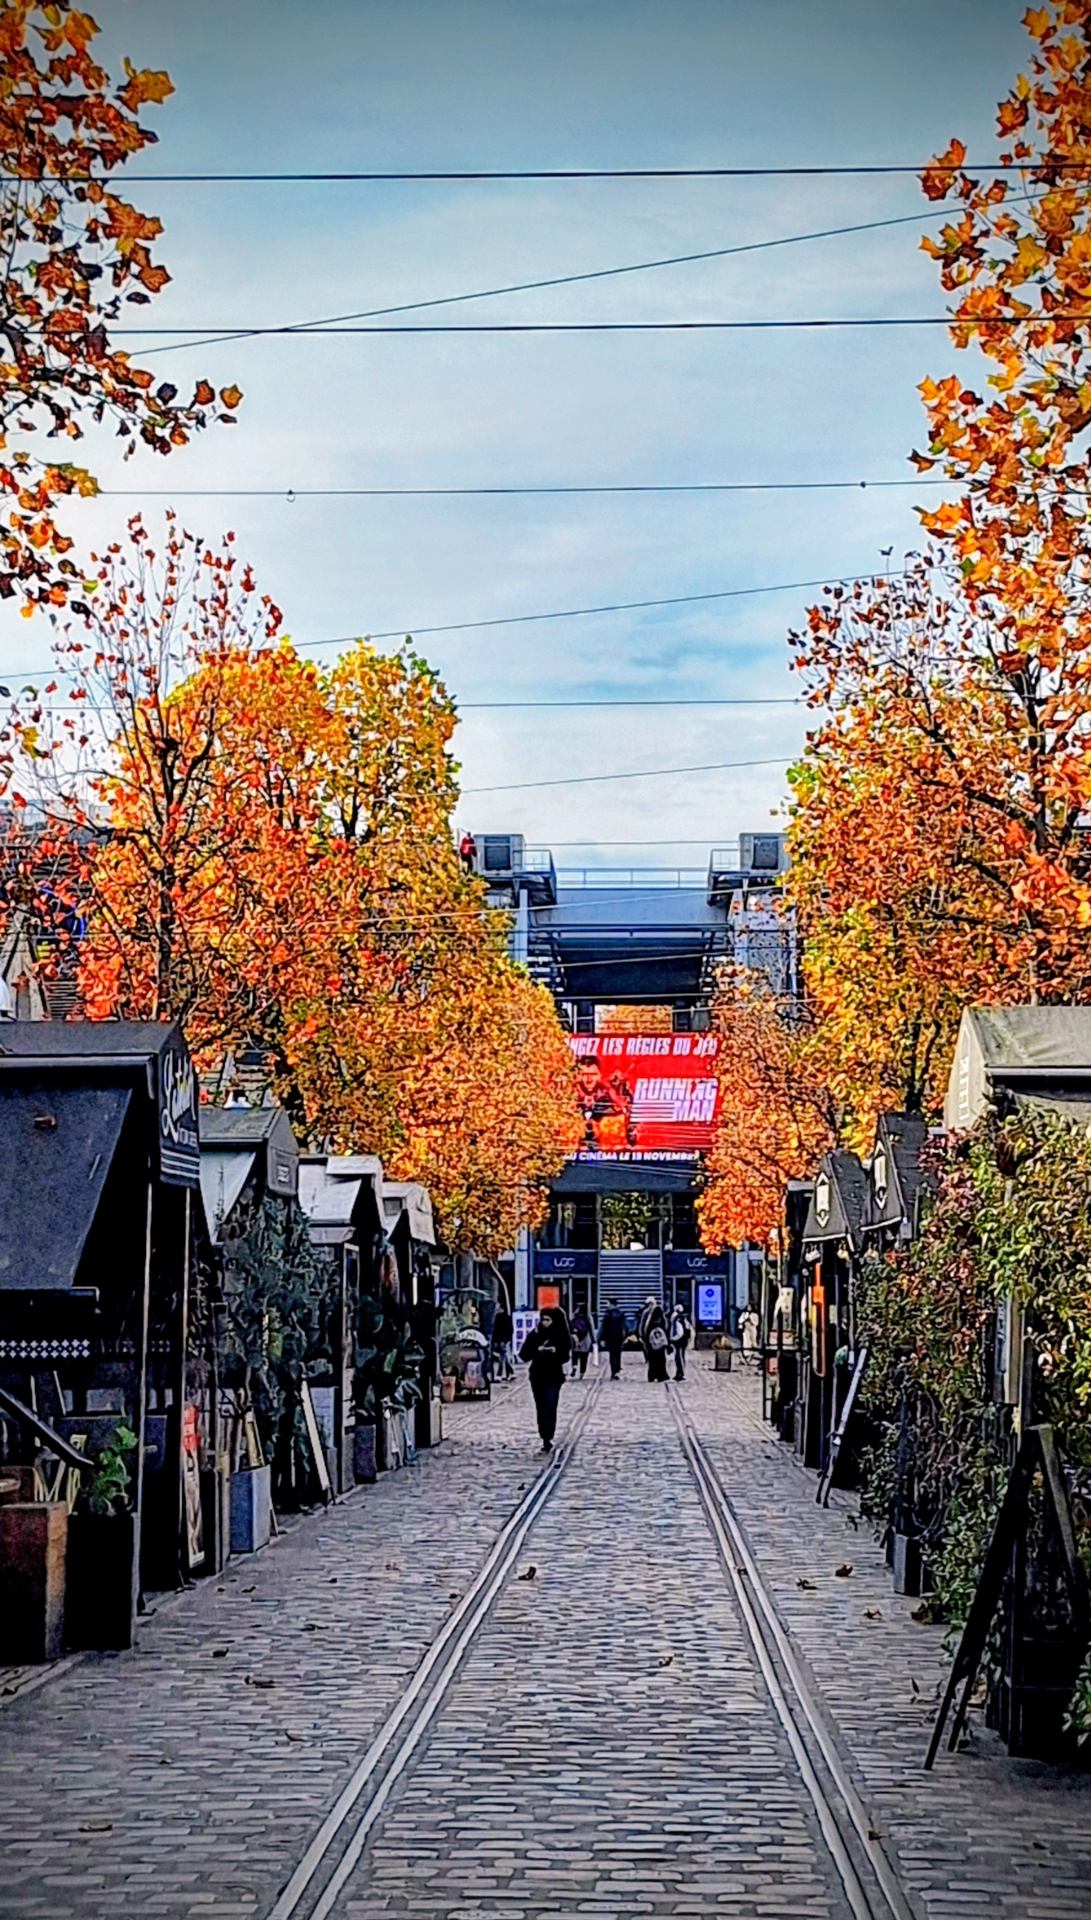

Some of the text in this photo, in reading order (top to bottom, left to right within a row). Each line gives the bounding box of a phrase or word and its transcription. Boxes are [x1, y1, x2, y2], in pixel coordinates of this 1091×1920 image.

[568, 1034, 718, 1056] NGEZ LES RÈGLES DU JEU
[633, 1077, 719, 1100] RUNNING
[674, 1100, 715, 1122] MAN
[579, 1150, 618, 1161] CINÉMA
[619, 1151, 631, 1161] LE
